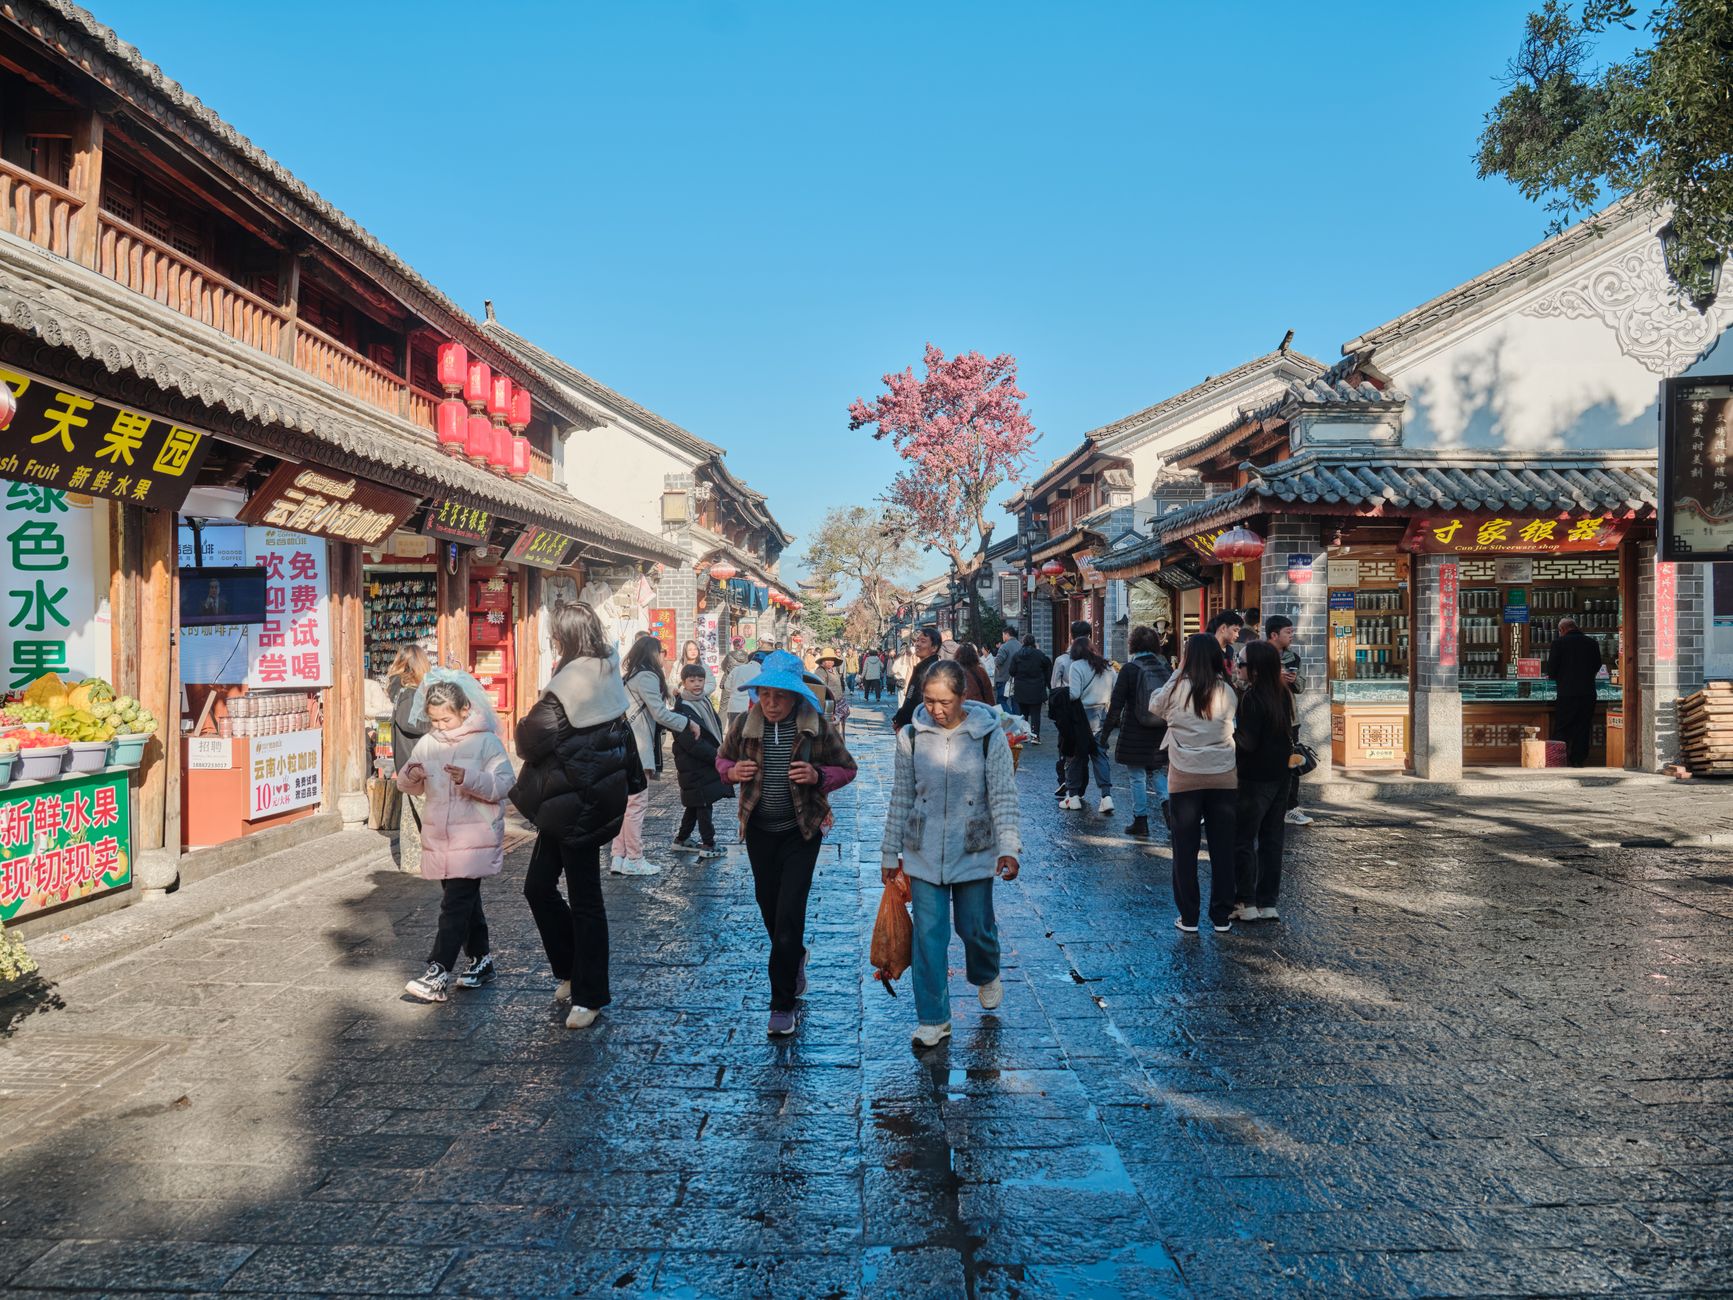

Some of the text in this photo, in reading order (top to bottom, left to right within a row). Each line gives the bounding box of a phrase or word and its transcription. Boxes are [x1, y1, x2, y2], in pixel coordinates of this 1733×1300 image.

[23, 459, 60, 481] Fruit
[68, 465, 153, 501] 新鲜水果
[263, 487, 396, 544] 云南小粒咖啡
[1433, 517, 1604, 545] 寸家银器
[5, 479, 70, 689] 绿色水果
[255, 551, 288, 683] 欢迎品尝
[288, 550, 321, 682] 免费试喝
[198, 740, 222, 753] 招聘
[254, 750, 318, 781] 云南小粒咖啡
[0, 787, 118, 848] 新鲜水果
[255, 783, 272, 812] 10
[1, 837, 119, 901] 现切现卖
